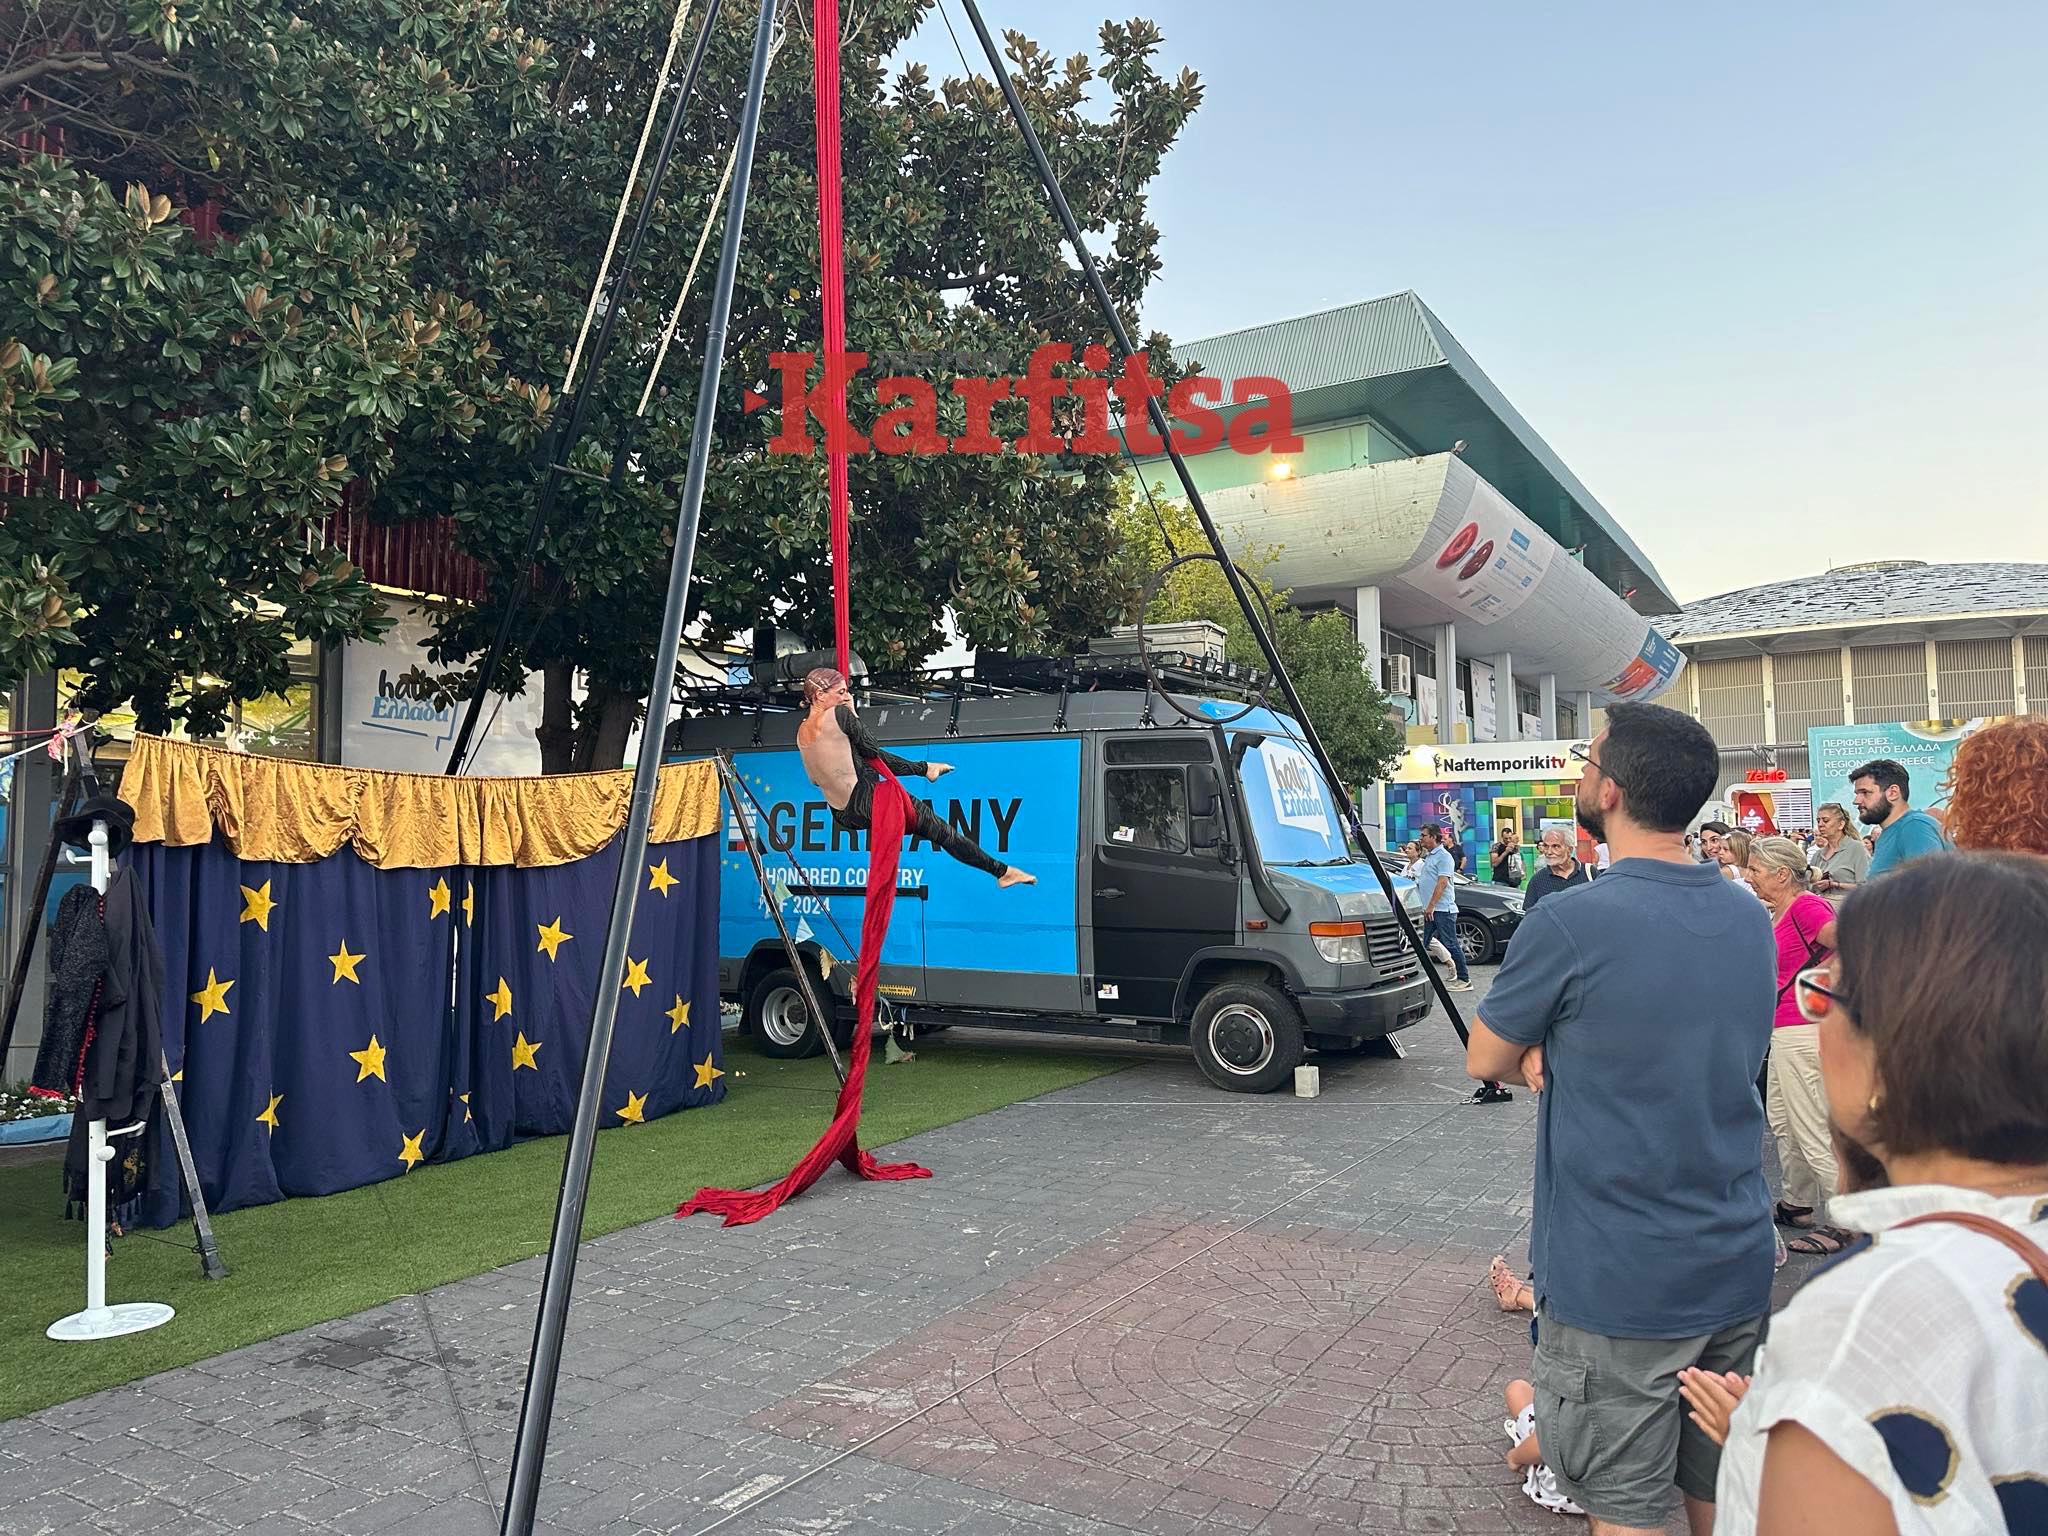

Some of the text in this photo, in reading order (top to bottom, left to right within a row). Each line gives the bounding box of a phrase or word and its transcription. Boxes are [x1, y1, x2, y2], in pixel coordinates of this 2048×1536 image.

[1822, 736, 1894, 748] ΠΕΡΙΦΕΡΕΙΕΣ:
[1823, 743, 1941, 756] ΓΕΥΣΕΙΣ ΑΠΟ ΕΛΛΑΔΑ
[768, 798, 1023, 853] GERANY
[766, 867, 841, 885] HONORED
[793, 896, 831, 914] 2024
